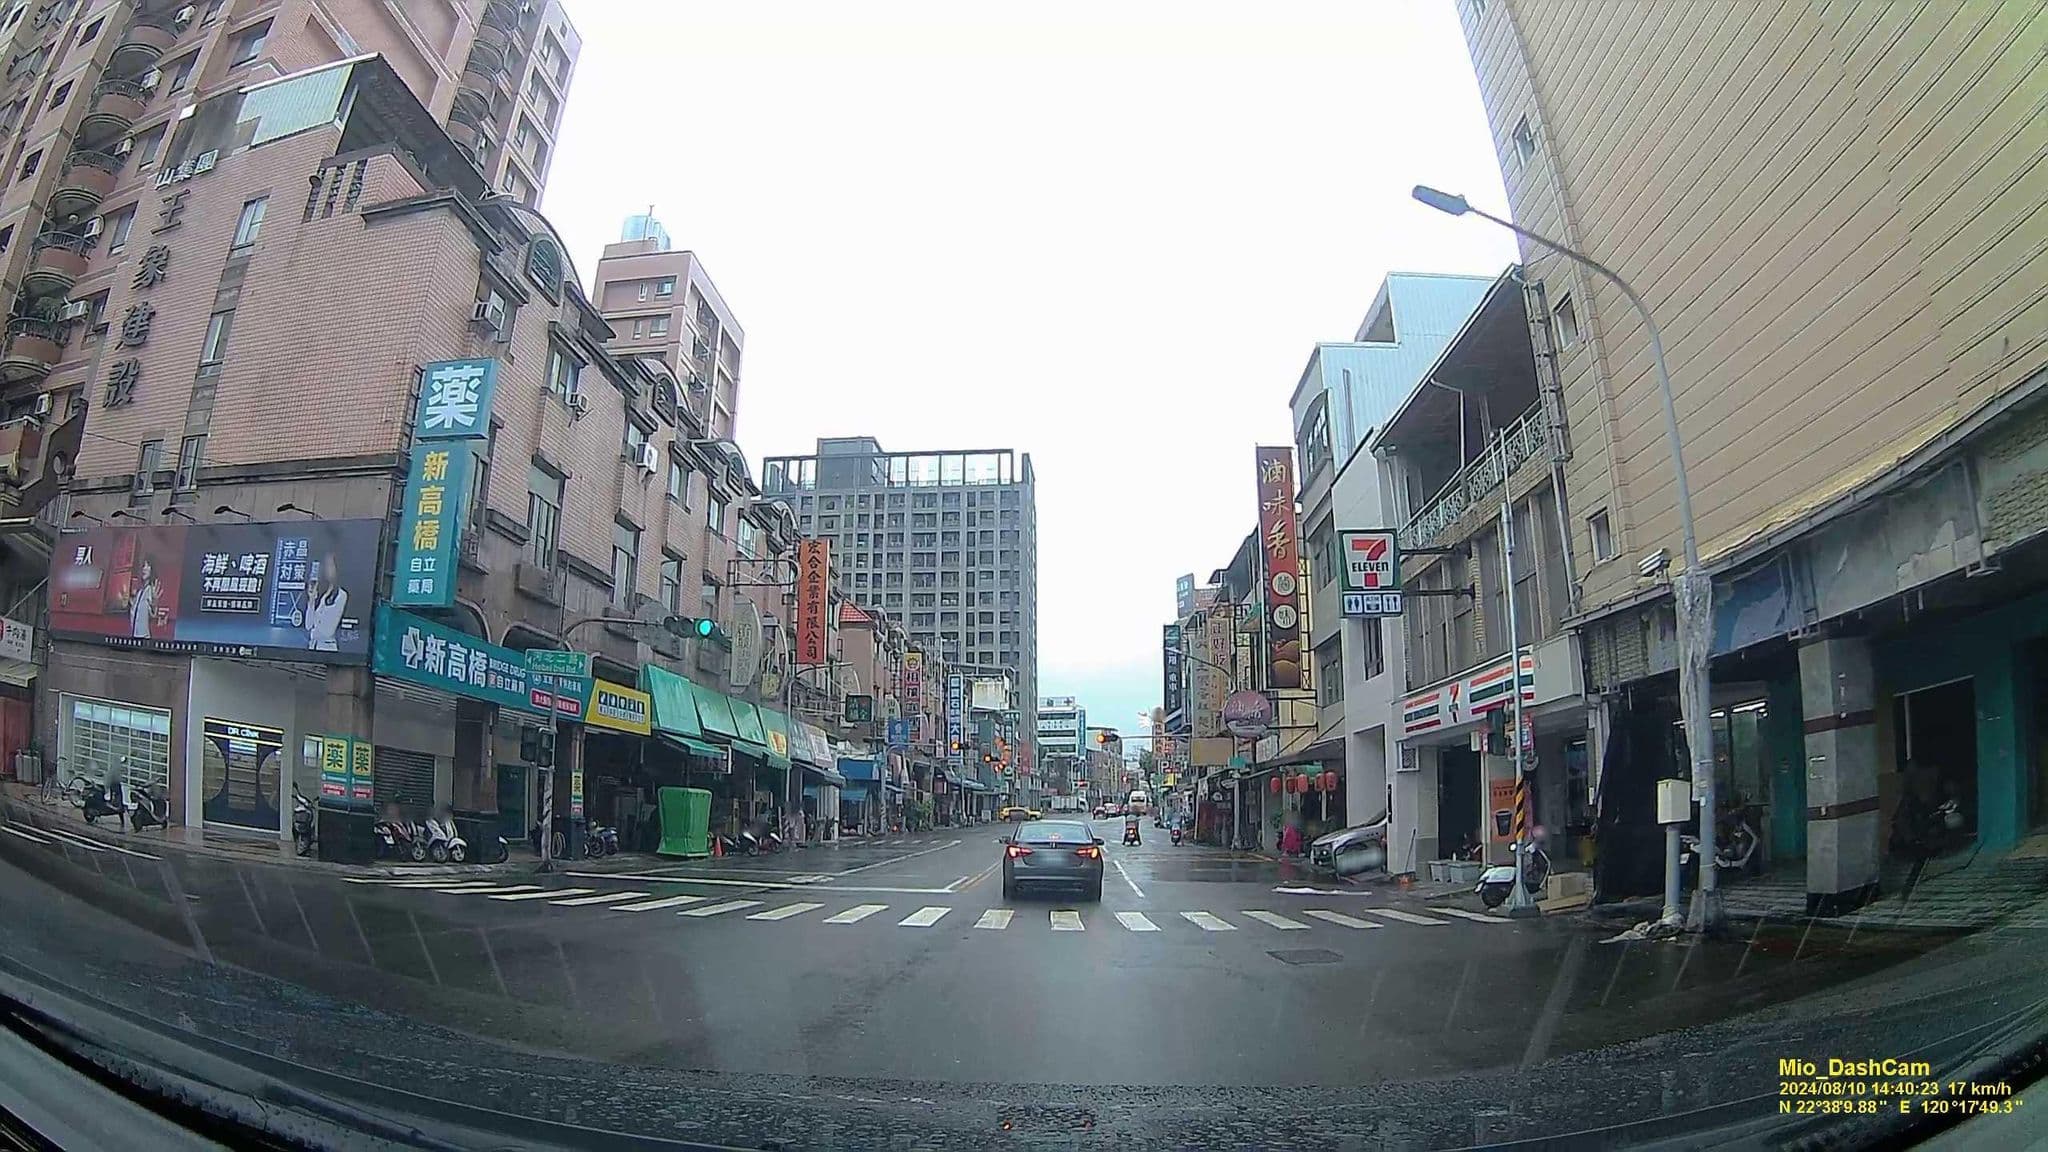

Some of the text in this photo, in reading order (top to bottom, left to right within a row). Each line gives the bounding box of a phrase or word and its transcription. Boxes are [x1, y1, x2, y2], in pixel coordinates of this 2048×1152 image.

[412, 450, 450, 553] 新高橋
[75, 546, 93, 565] 男人
[410, 556, 437, 572] 自立
[805, 541, 822, 659] 宏合企業有限公司
[424, 633, 490, 689] 新高橋
